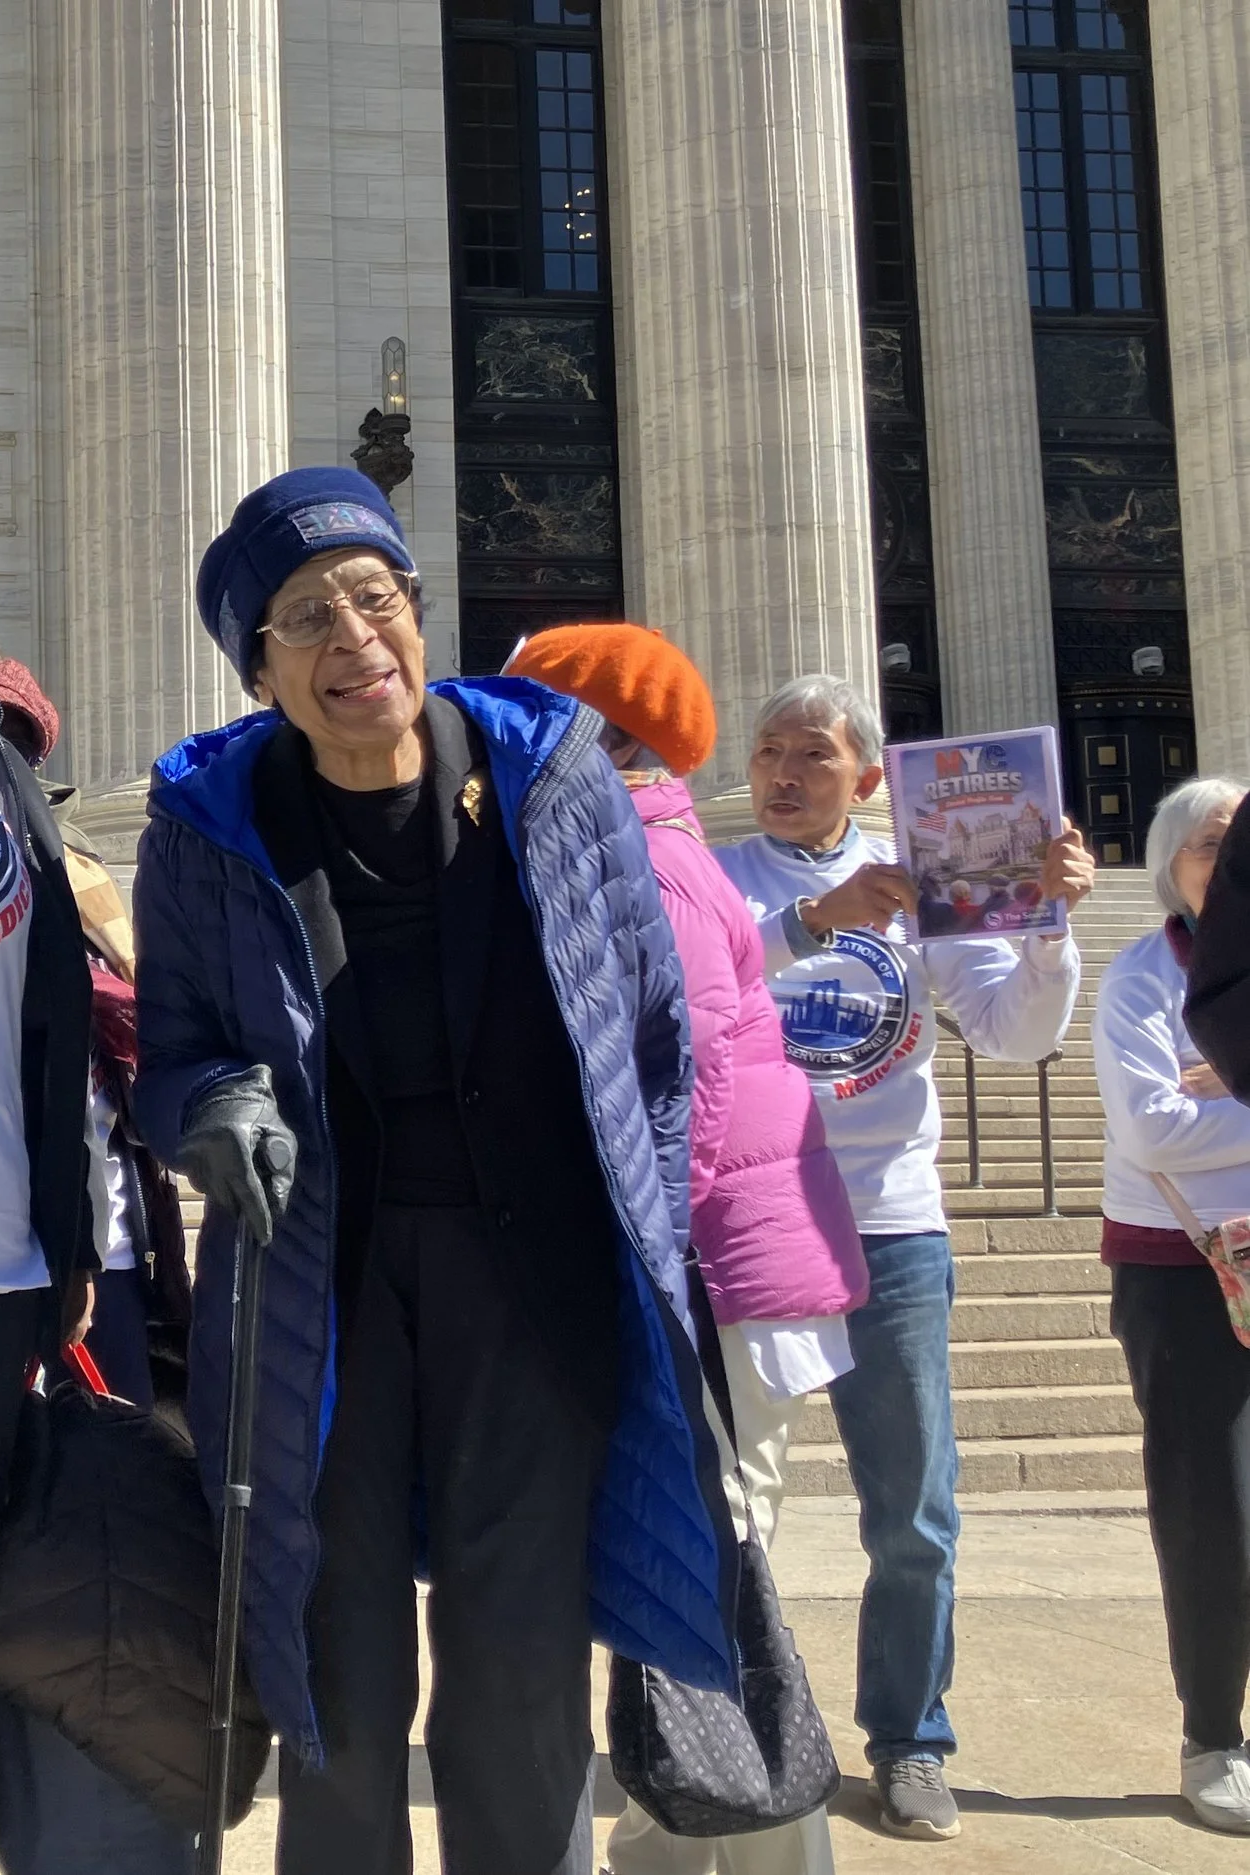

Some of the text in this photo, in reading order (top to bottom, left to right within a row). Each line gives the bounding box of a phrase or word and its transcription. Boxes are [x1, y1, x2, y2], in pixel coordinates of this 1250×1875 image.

[934, 744, 1008, 780] NYC
[924, 771, 1023, 801] RETIREES
[877, 960, 895, 979] OF
[785, 1044, 841, 1065] SERVICE
